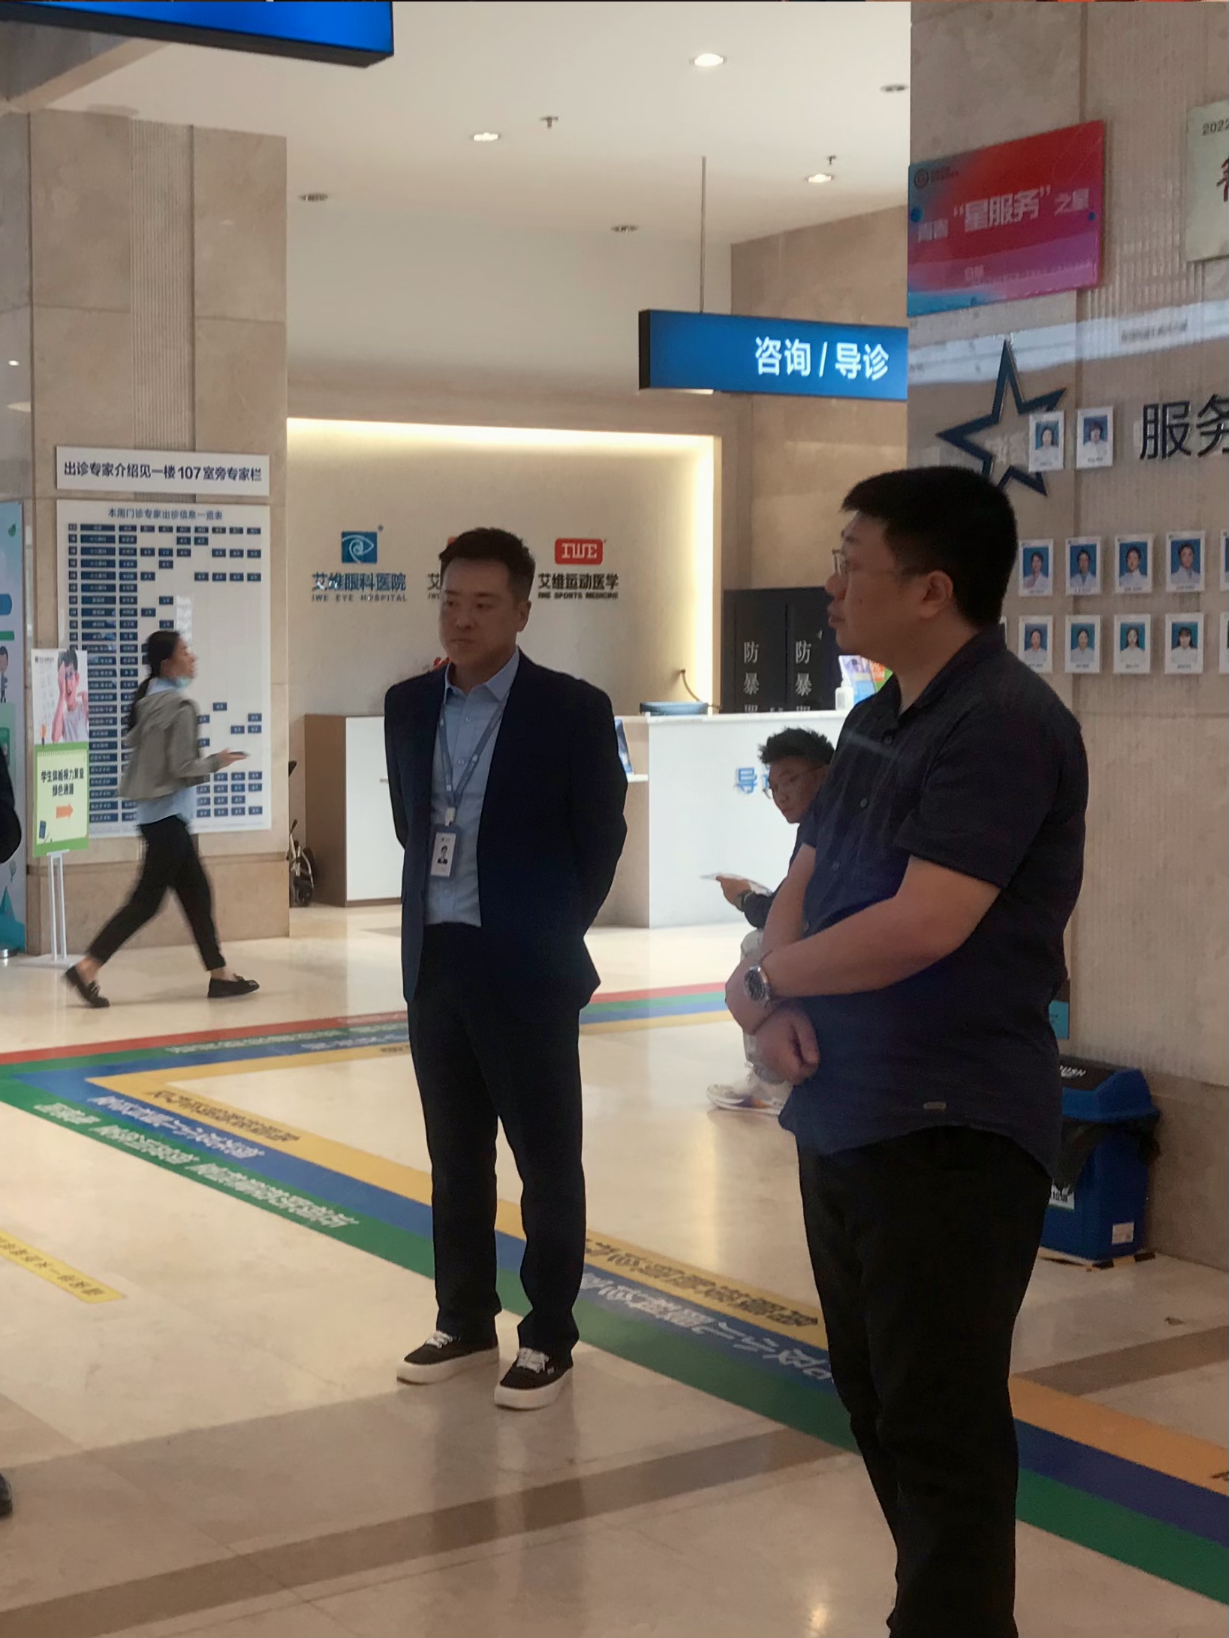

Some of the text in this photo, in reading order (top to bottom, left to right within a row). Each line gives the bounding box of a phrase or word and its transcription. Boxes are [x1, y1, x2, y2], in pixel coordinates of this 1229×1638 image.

[562, 543, 597, 559] IWE
[312, 572, 406, 591] 艾维眼科医院
[538, 572, 619, 591] 艾维运动医学
[312, 594, 407, 602] IWE EYE HOSPITAL
